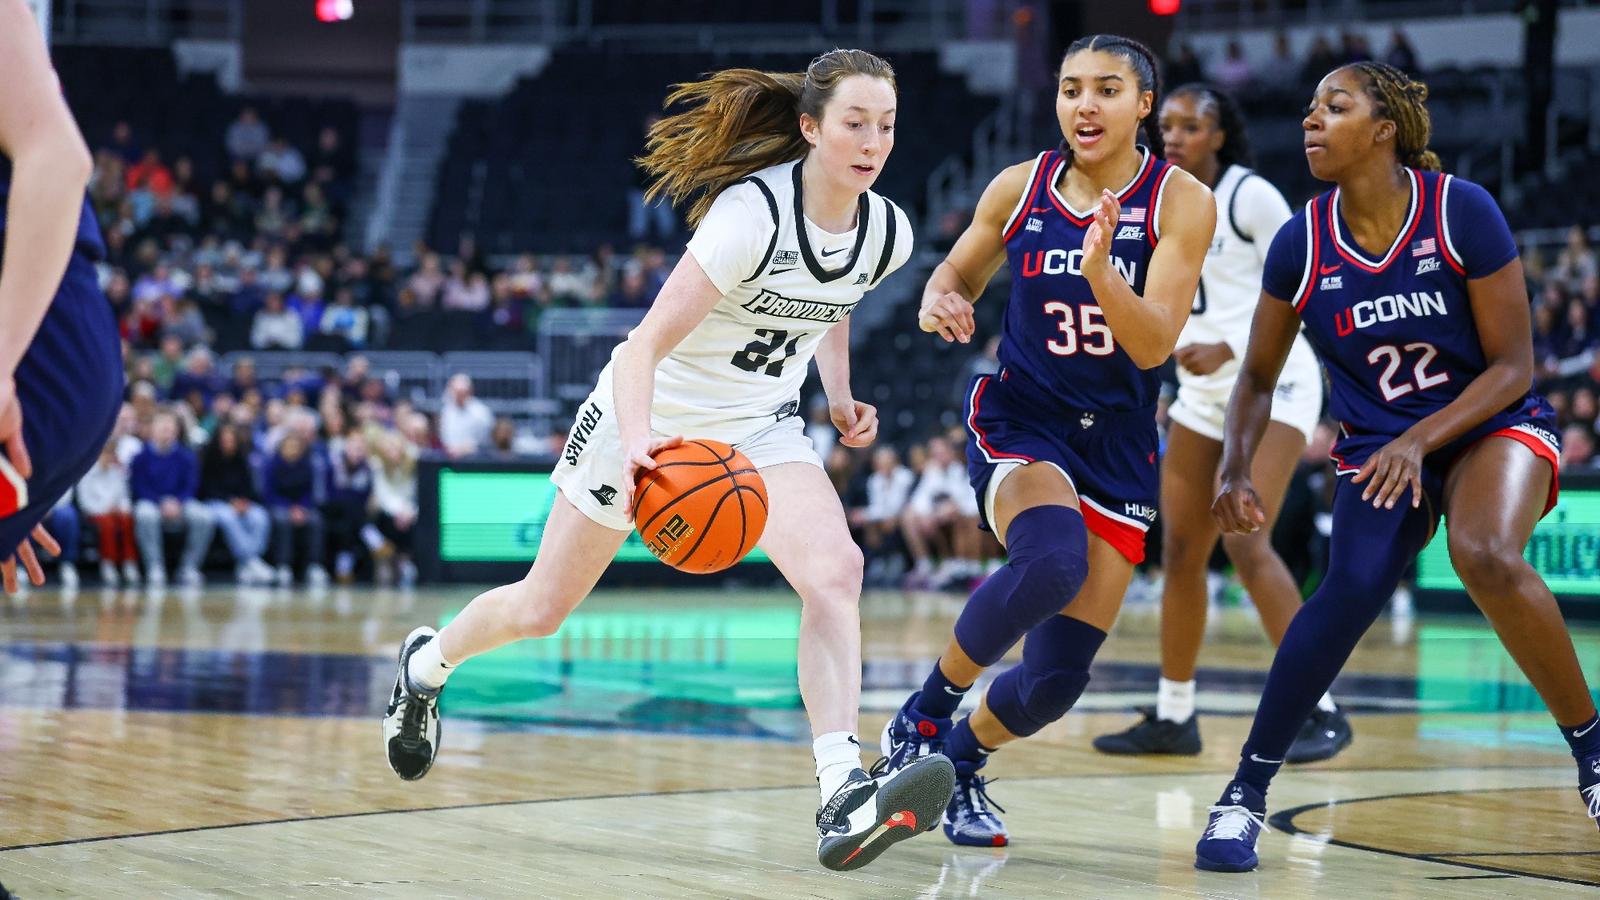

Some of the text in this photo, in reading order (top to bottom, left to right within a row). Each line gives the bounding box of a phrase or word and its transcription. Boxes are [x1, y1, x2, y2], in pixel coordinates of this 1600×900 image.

[1116, 231, 1145, 240] EAST
[1120, 225, 1141, 233] BIG
[1043, 301, 1115, 357] 35
[1334, 291, 1448, 337] UCONN
[730, 328, 808, 378] 21
[1367, 342, 1449, 402] 22
[565, 401, 603, 467] FRIARS
